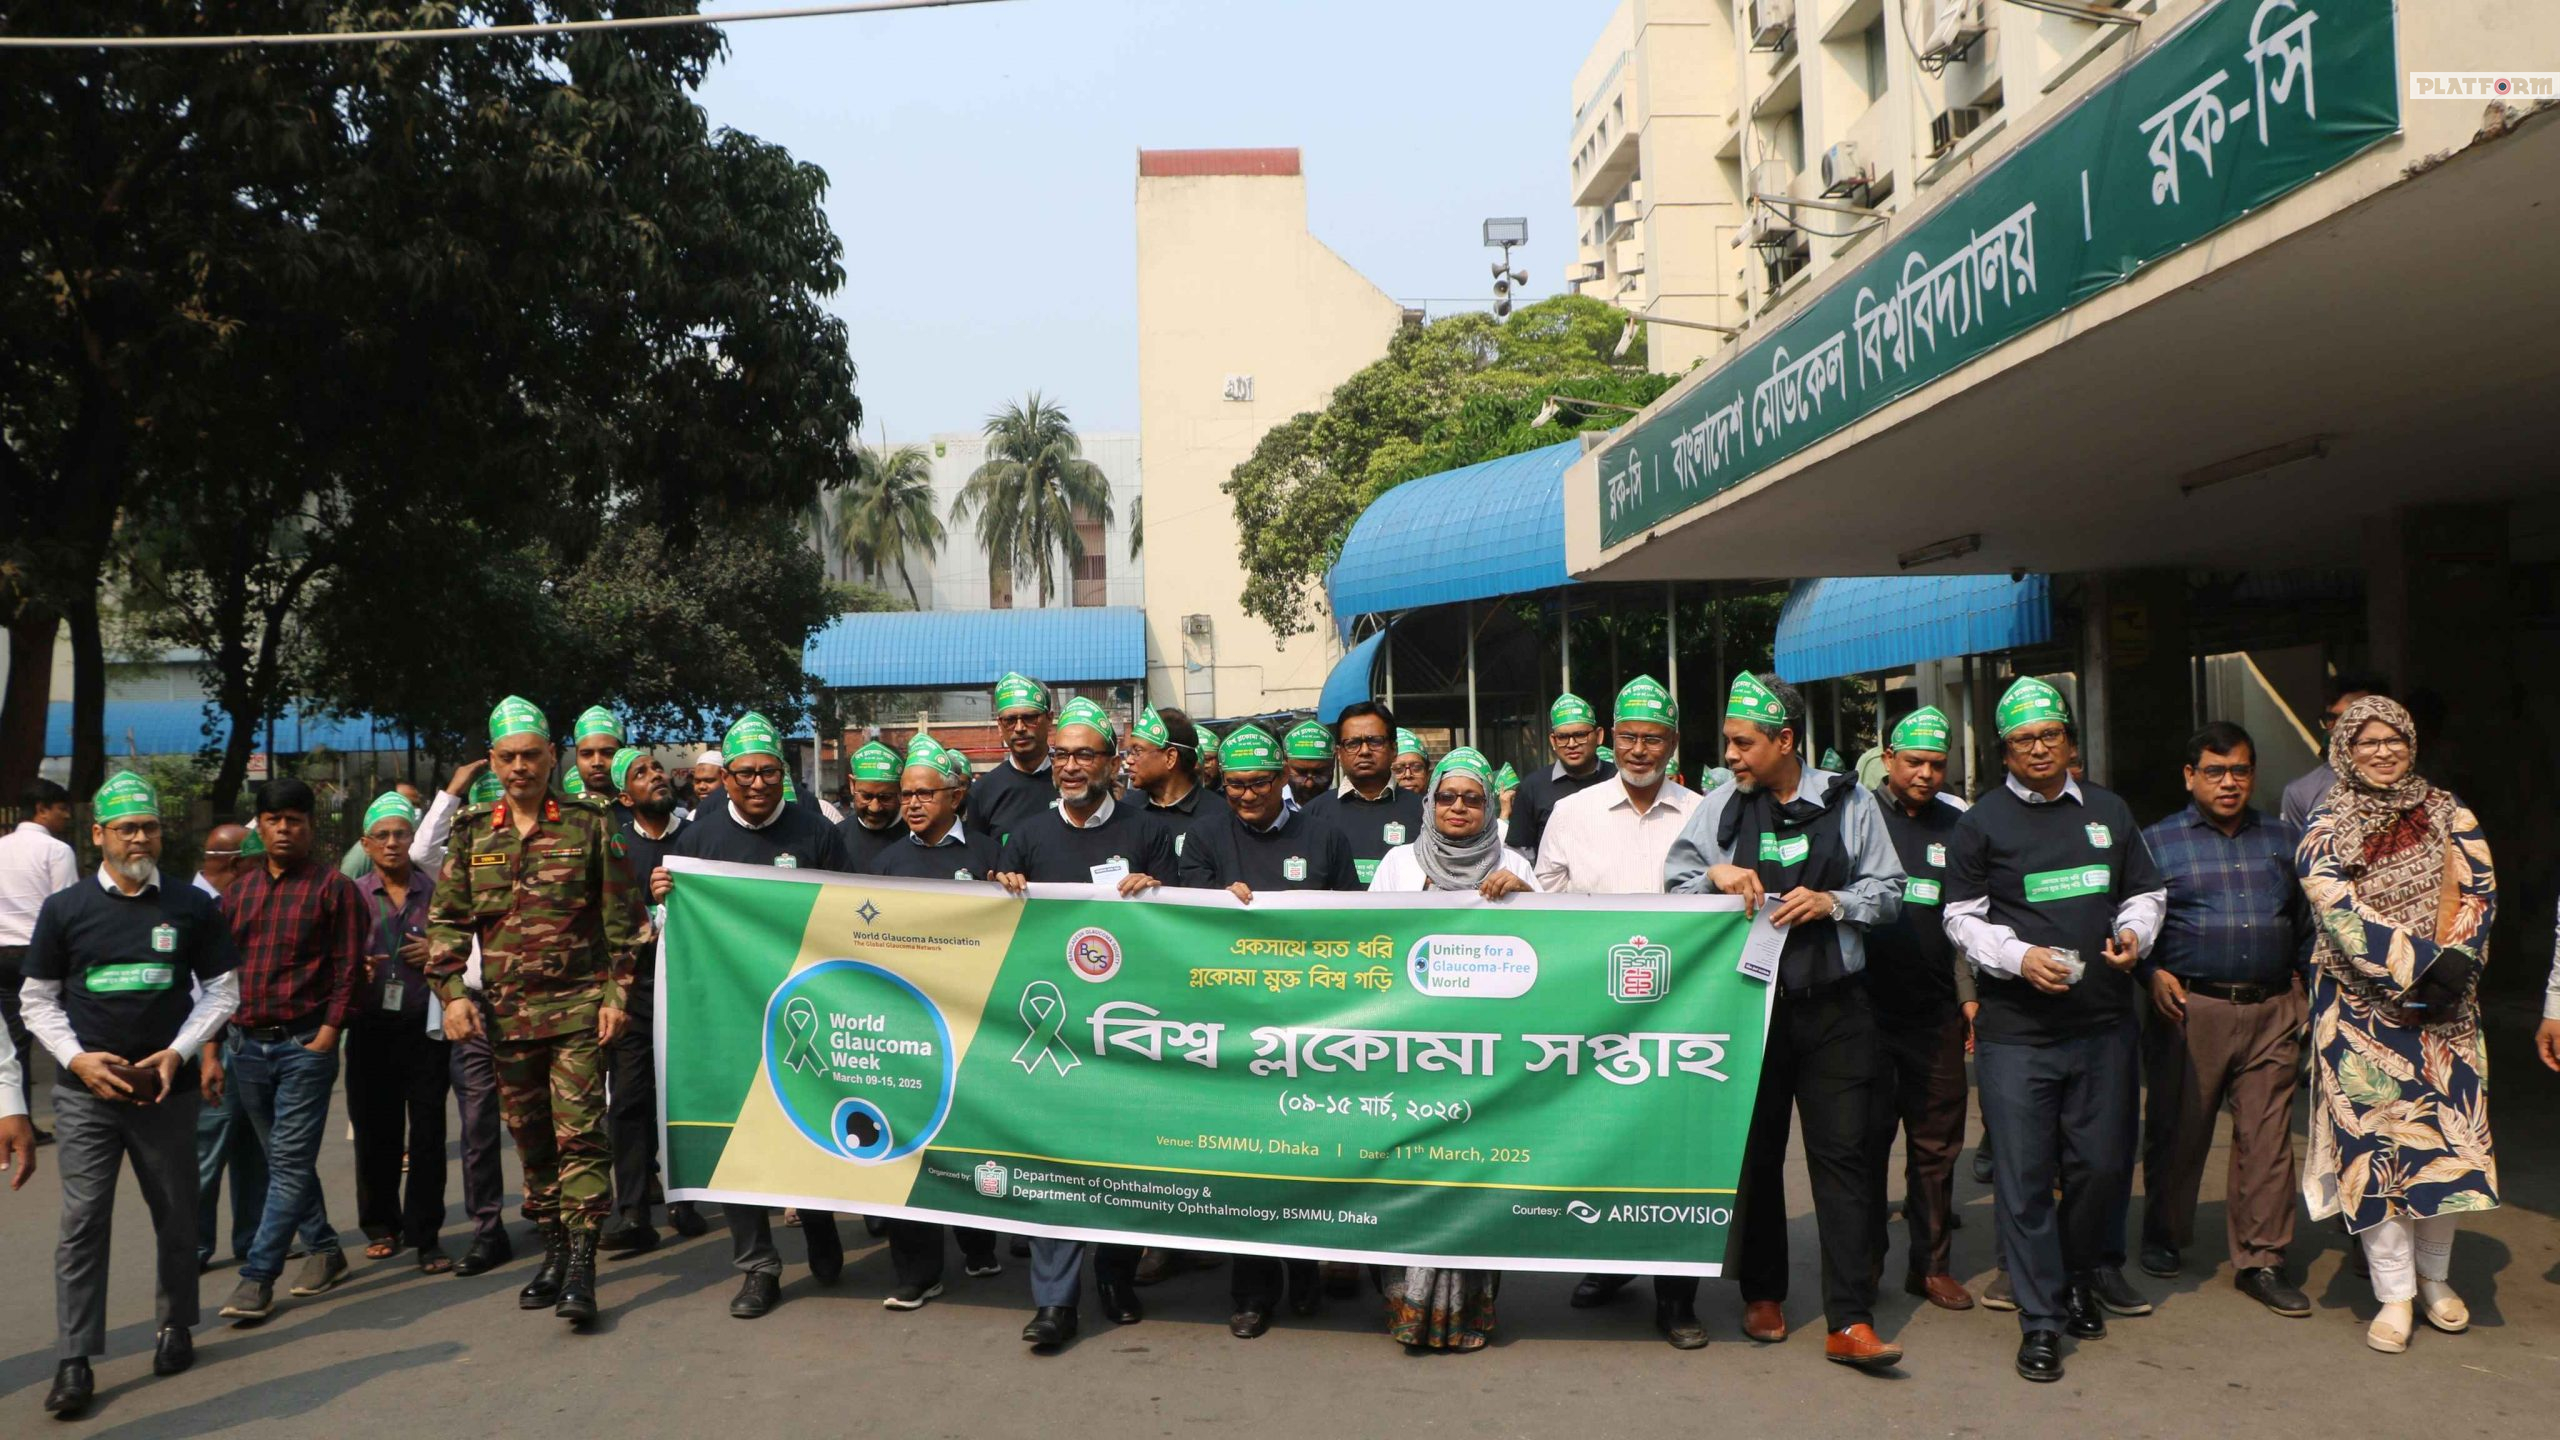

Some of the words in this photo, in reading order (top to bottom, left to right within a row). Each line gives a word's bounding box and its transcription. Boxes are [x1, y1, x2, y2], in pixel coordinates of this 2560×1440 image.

[1607, 447, 1643, 521] ব্লক-সি
[1671, 388, 1745, 491] বাংলাদেশ
[1752, 327, 1846, 447] মেডিকেল
[1852, 201, 2038, 391] বিশ্ববিদ্যালয়
[2138, 0, 2320, 205] ব্লক-সি
[853, 931, 880, 941] World
[881, 933, 926, 944] Glaucoma
[928, 936, 980, 946] Association
[1230, 938, 1307, 957] একসাথে
[1312, 940, 1350, 958] হাত
[1357, 934, 1394, 959] ধরি
[1080, 943, 1108, 969] BGS
[1433, 944, 1481, 959] Uniting
[1484, 945, 1503, 956] for
[1506, 947, 1514, 956] a
[1189, 967, 1257, 988] গ্লকোমা
[1263, 969, 1303, 993] মুক্ত
[1309, 964, 1347, 990] বিশ্ব
[1354, 965, 1394, 993] গড়ি
[1433, 961, 1531, 973] Glaucoma-Free
[1432, 977, 1471, 988] World
[829, 1013, 885, 1032] World
[830, 1031, 932, 1056] Glaucoma
[1086, 1001, 1225, 1068] বিশ্ব
[1249, 1026, 1502, 1078] গ্লকোমা
[1521, 1033, 1731, 1085] সপ্তাহ
[831, 1052, 881, 1070] Week
[833, 1072, 863, 1084] March
[865, 1075, 896, 1088] 09-15,
[898, 1078, 922, 1089] 2025
[1279, 1090, 1352, 1116] (০৯-১৫
[1358, 1092, 1397, 1121] মার্চ,
[1406, 1099, 1472, 1124] ২০২৫)
[1156, 1136, 1194, 1148] Venue:
[1198, 1135, 1264, 1154] BSMMU,
[1268, 1139, 1320, 1156] Dhaka
[1359, 1149, 1390, 1160] Date:
[1429, 1146, 1486, 1163] March,
[1490, 1148, 1531, 1163] 2025
[928, 1167, 961, 1180] Organized
[962, 1171, 973, 1181] by:
[1013, 1168, 1086, 1187] Department
[1088, 1174, 1101, 1188] of
[1103, 1179, 1200, 1200] Ophthalmology
[1202, 1186, 1212, 1198] &
[1012, 1186, 1087, 1203] Department
[1089, 1190, 1102, 1204] of
[1104, 1195, 1175, 1214] Community
[1177, 1201, 1280, 1221] Ophthalmology,
[1282, 1208, 1335, 1223] BSMMU,
[1338, 1210, 1379, 1226] Dhaka
[1512, 1204, 1563, 1217] Courtesy:
